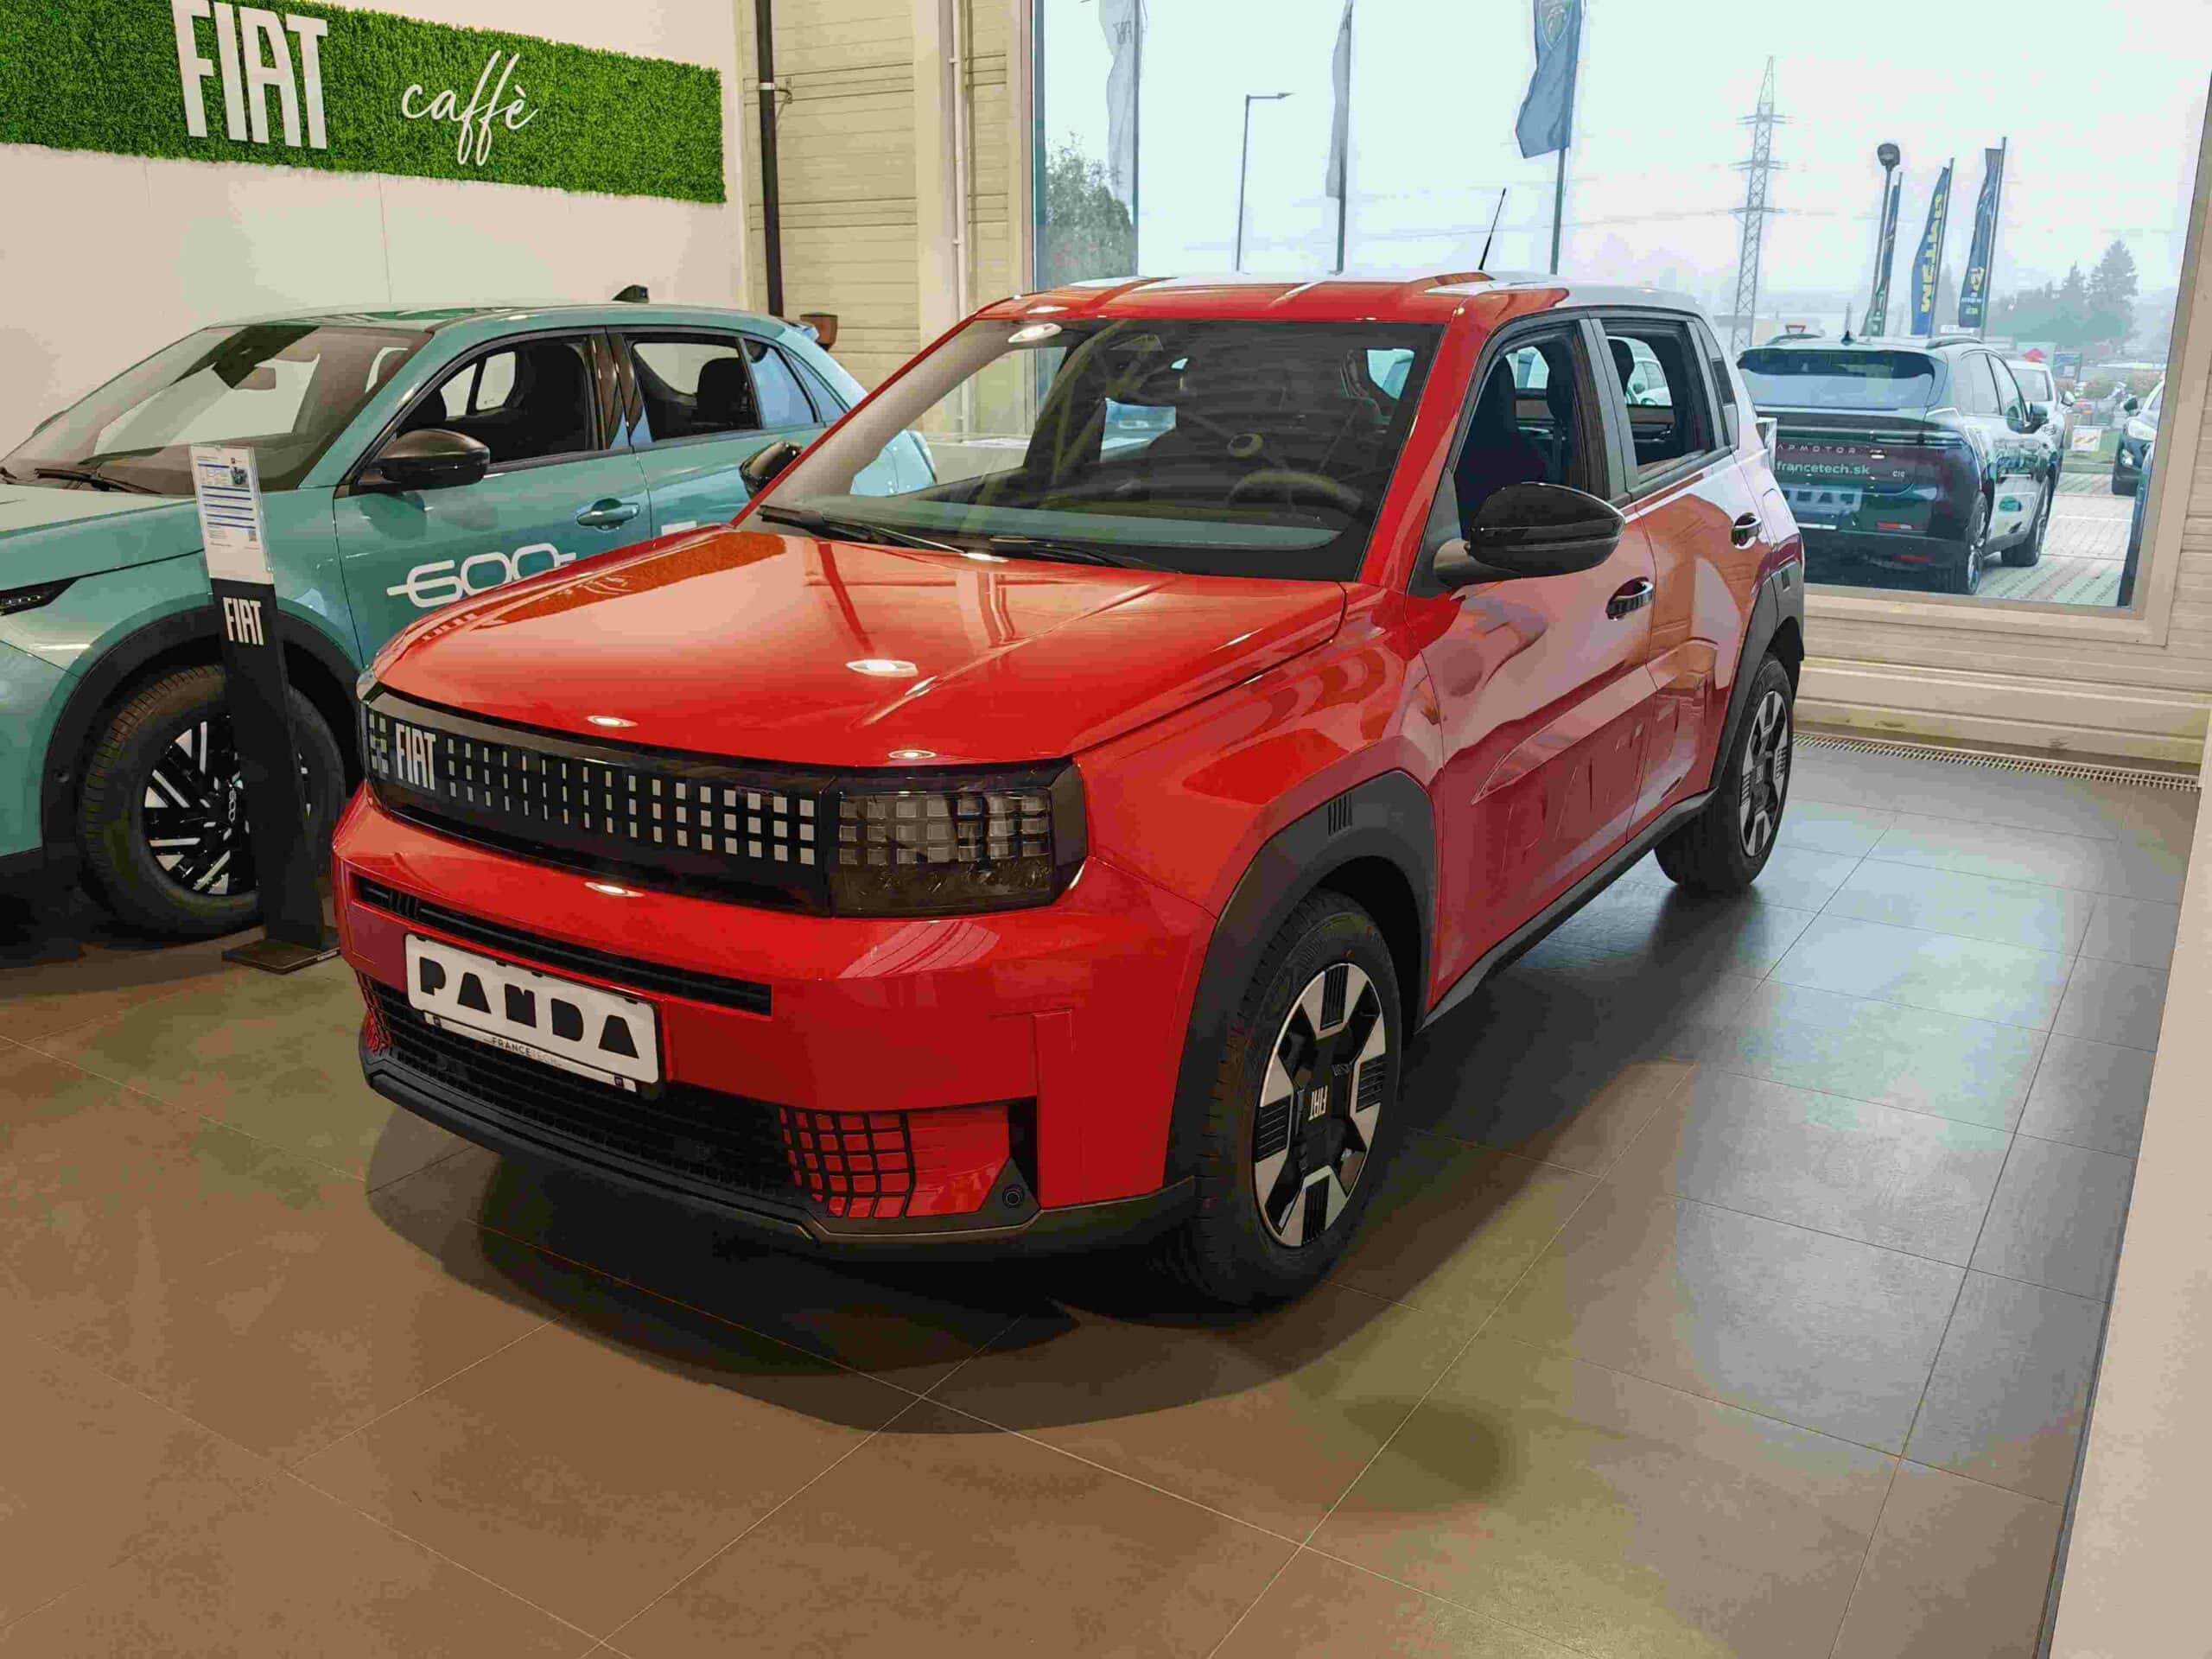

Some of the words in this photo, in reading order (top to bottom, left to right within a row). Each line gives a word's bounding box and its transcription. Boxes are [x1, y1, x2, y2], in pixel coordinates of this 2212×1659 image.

[172, 0, 329, 149] FIAT
[401, 50, 540, 166] caffè
[1777, 444, 1856, 454] APMOTOR
[387, 543, 576, 607] 600
[223, 597, 264, 645] FIAT
[395, 723, 436, 790] FIAT
[419, 957, 639, 1058] PANDA
[1308, 1085, 1328, 1122] FIAT
